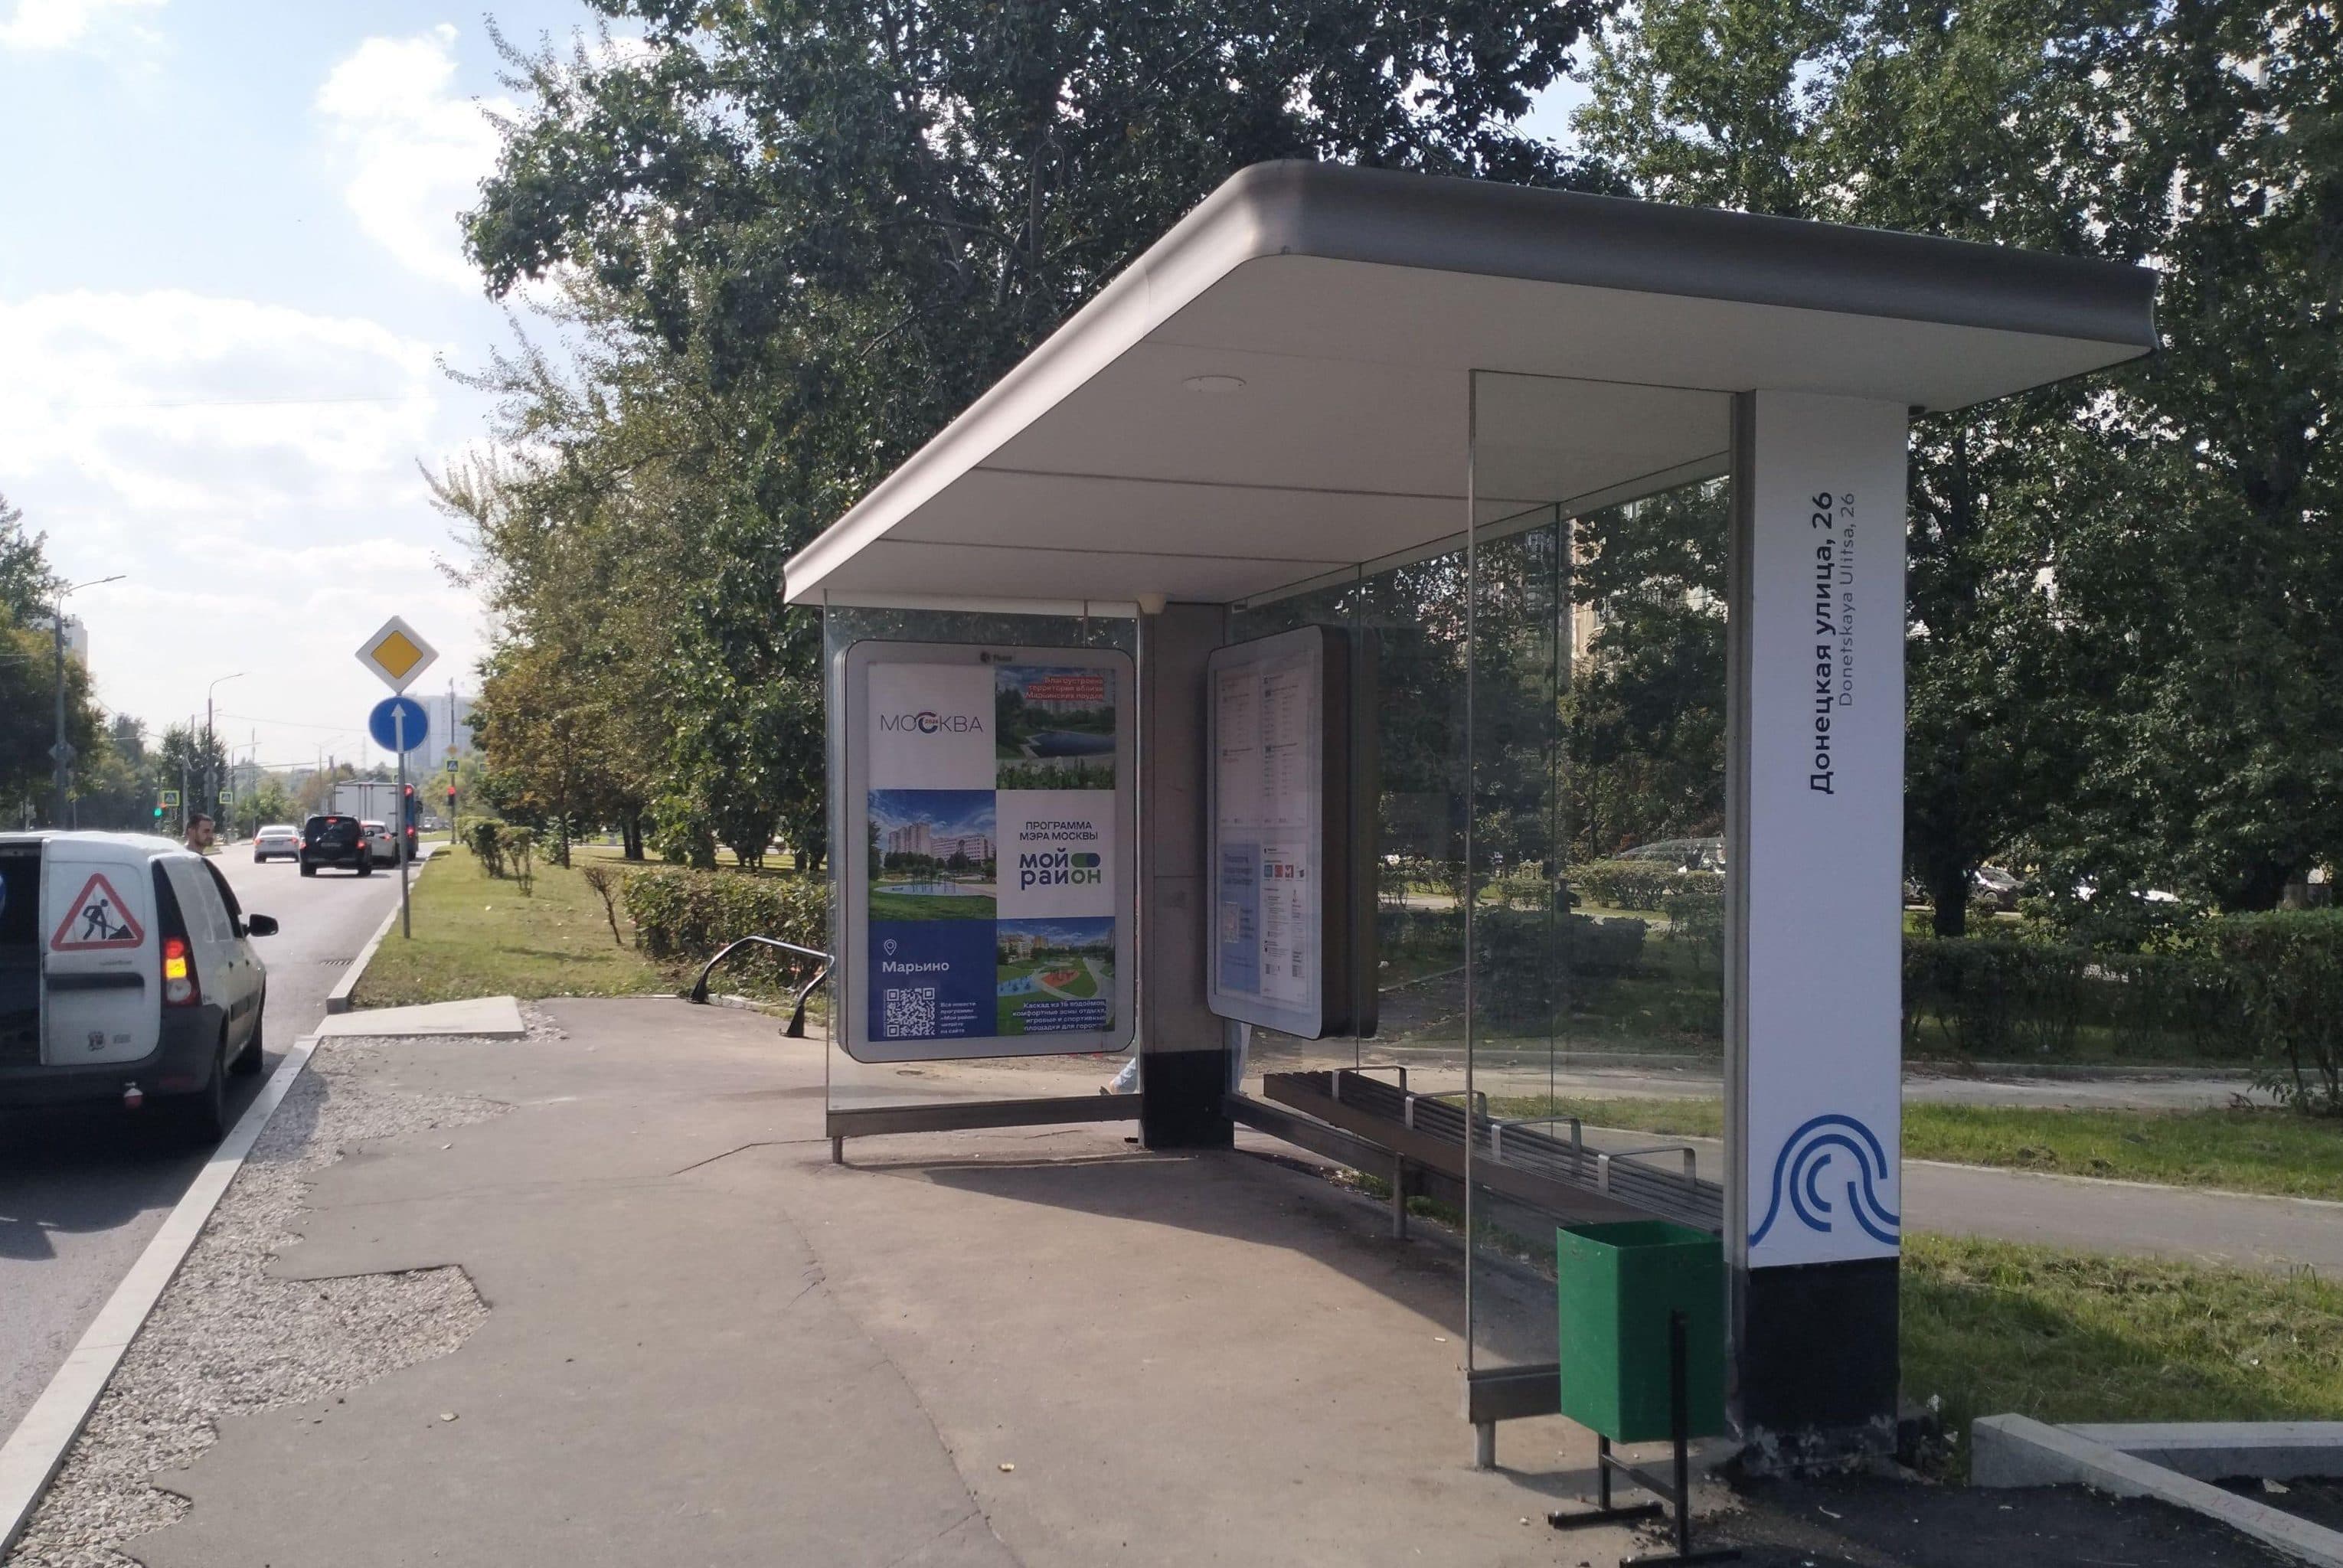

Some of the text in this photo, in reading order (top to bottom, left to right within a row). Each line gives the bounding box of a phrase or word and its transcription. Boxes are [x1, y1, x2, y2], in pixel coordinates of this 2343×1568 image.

[1839, 493, 1856, 706] Donetskaya Ulitsa, 26
[1810, 492, 1836, 794] Донецкая улица, 26
[881, 711, 984, 733] МОСКВА
[1020, 831, 1098, 841] МЭРА МОСКВЫ
[1026, 822, 1092, 830] ПРОГРАММА
[1019, 848, 1069, 868] мой
[882, 962, 949, 974] Марьино
